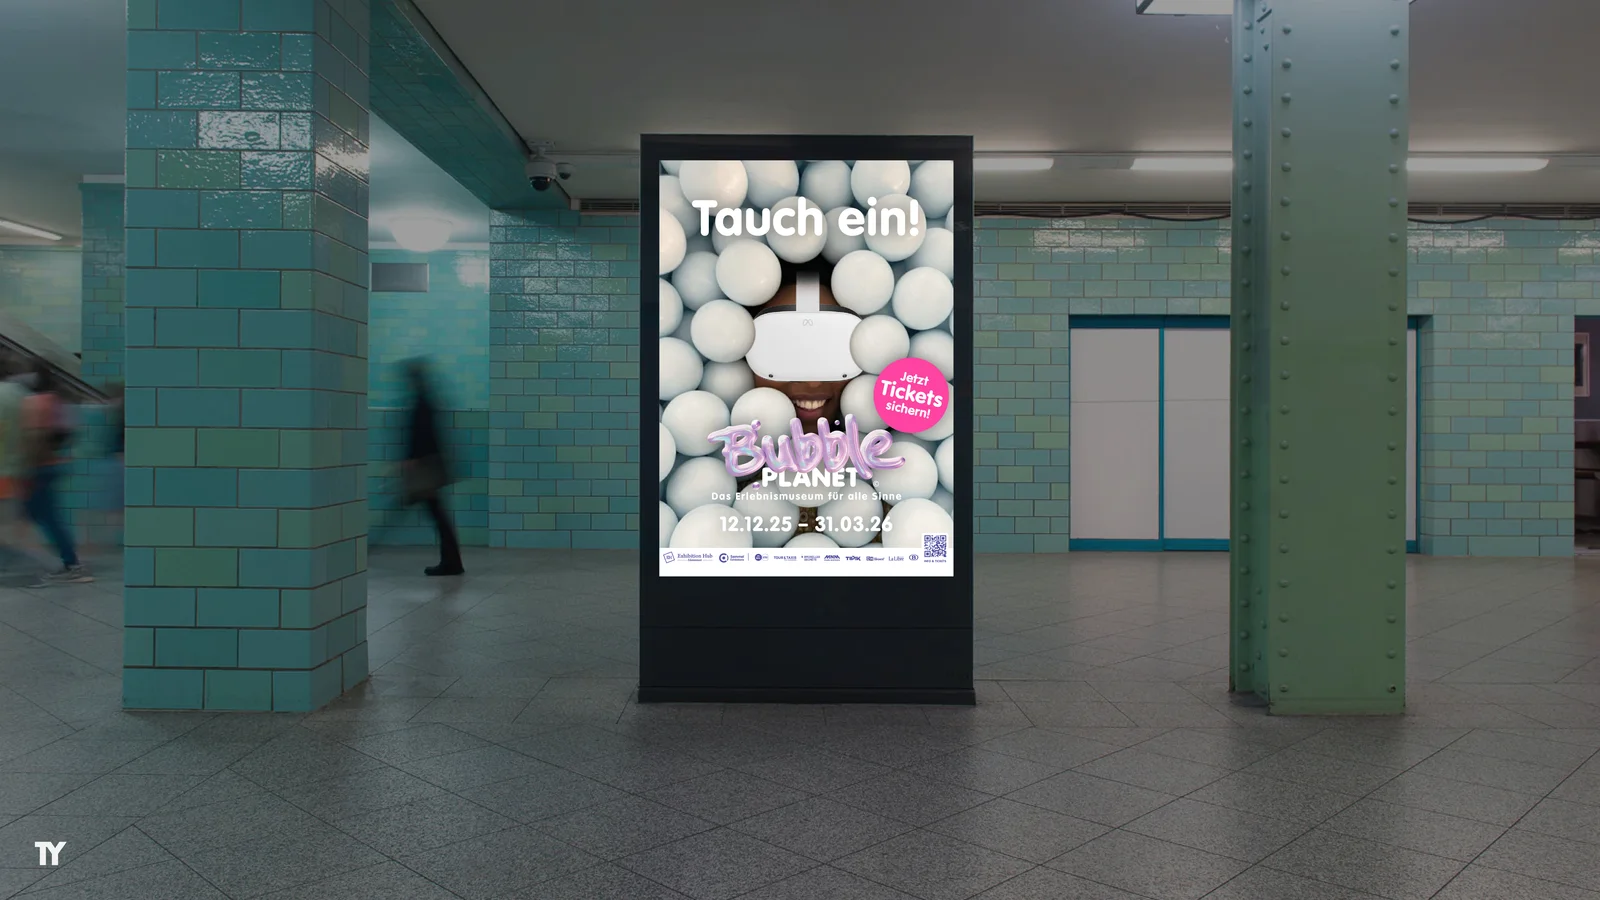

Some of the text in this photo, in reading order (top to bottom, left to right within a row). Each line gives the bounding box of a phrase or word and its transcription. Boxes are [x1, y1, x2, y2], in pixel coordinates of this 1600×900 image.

[691, 196, 919, 237] Tauch ein!
[899, 371, 930, 387] Jetzt
[881, 379, 944, 408] Tickets
[885, 400, 931, 419] sichern!
[707, 413, 906, 480] Bubble
[761, 467, 859, 488] PLANET
[711, 491, 902, 501] Das Erlebnismuseum für alle Sinne
[719, 515, 792, 533] 12.12.25
[814, 515, 893, 533] 31.03.26
